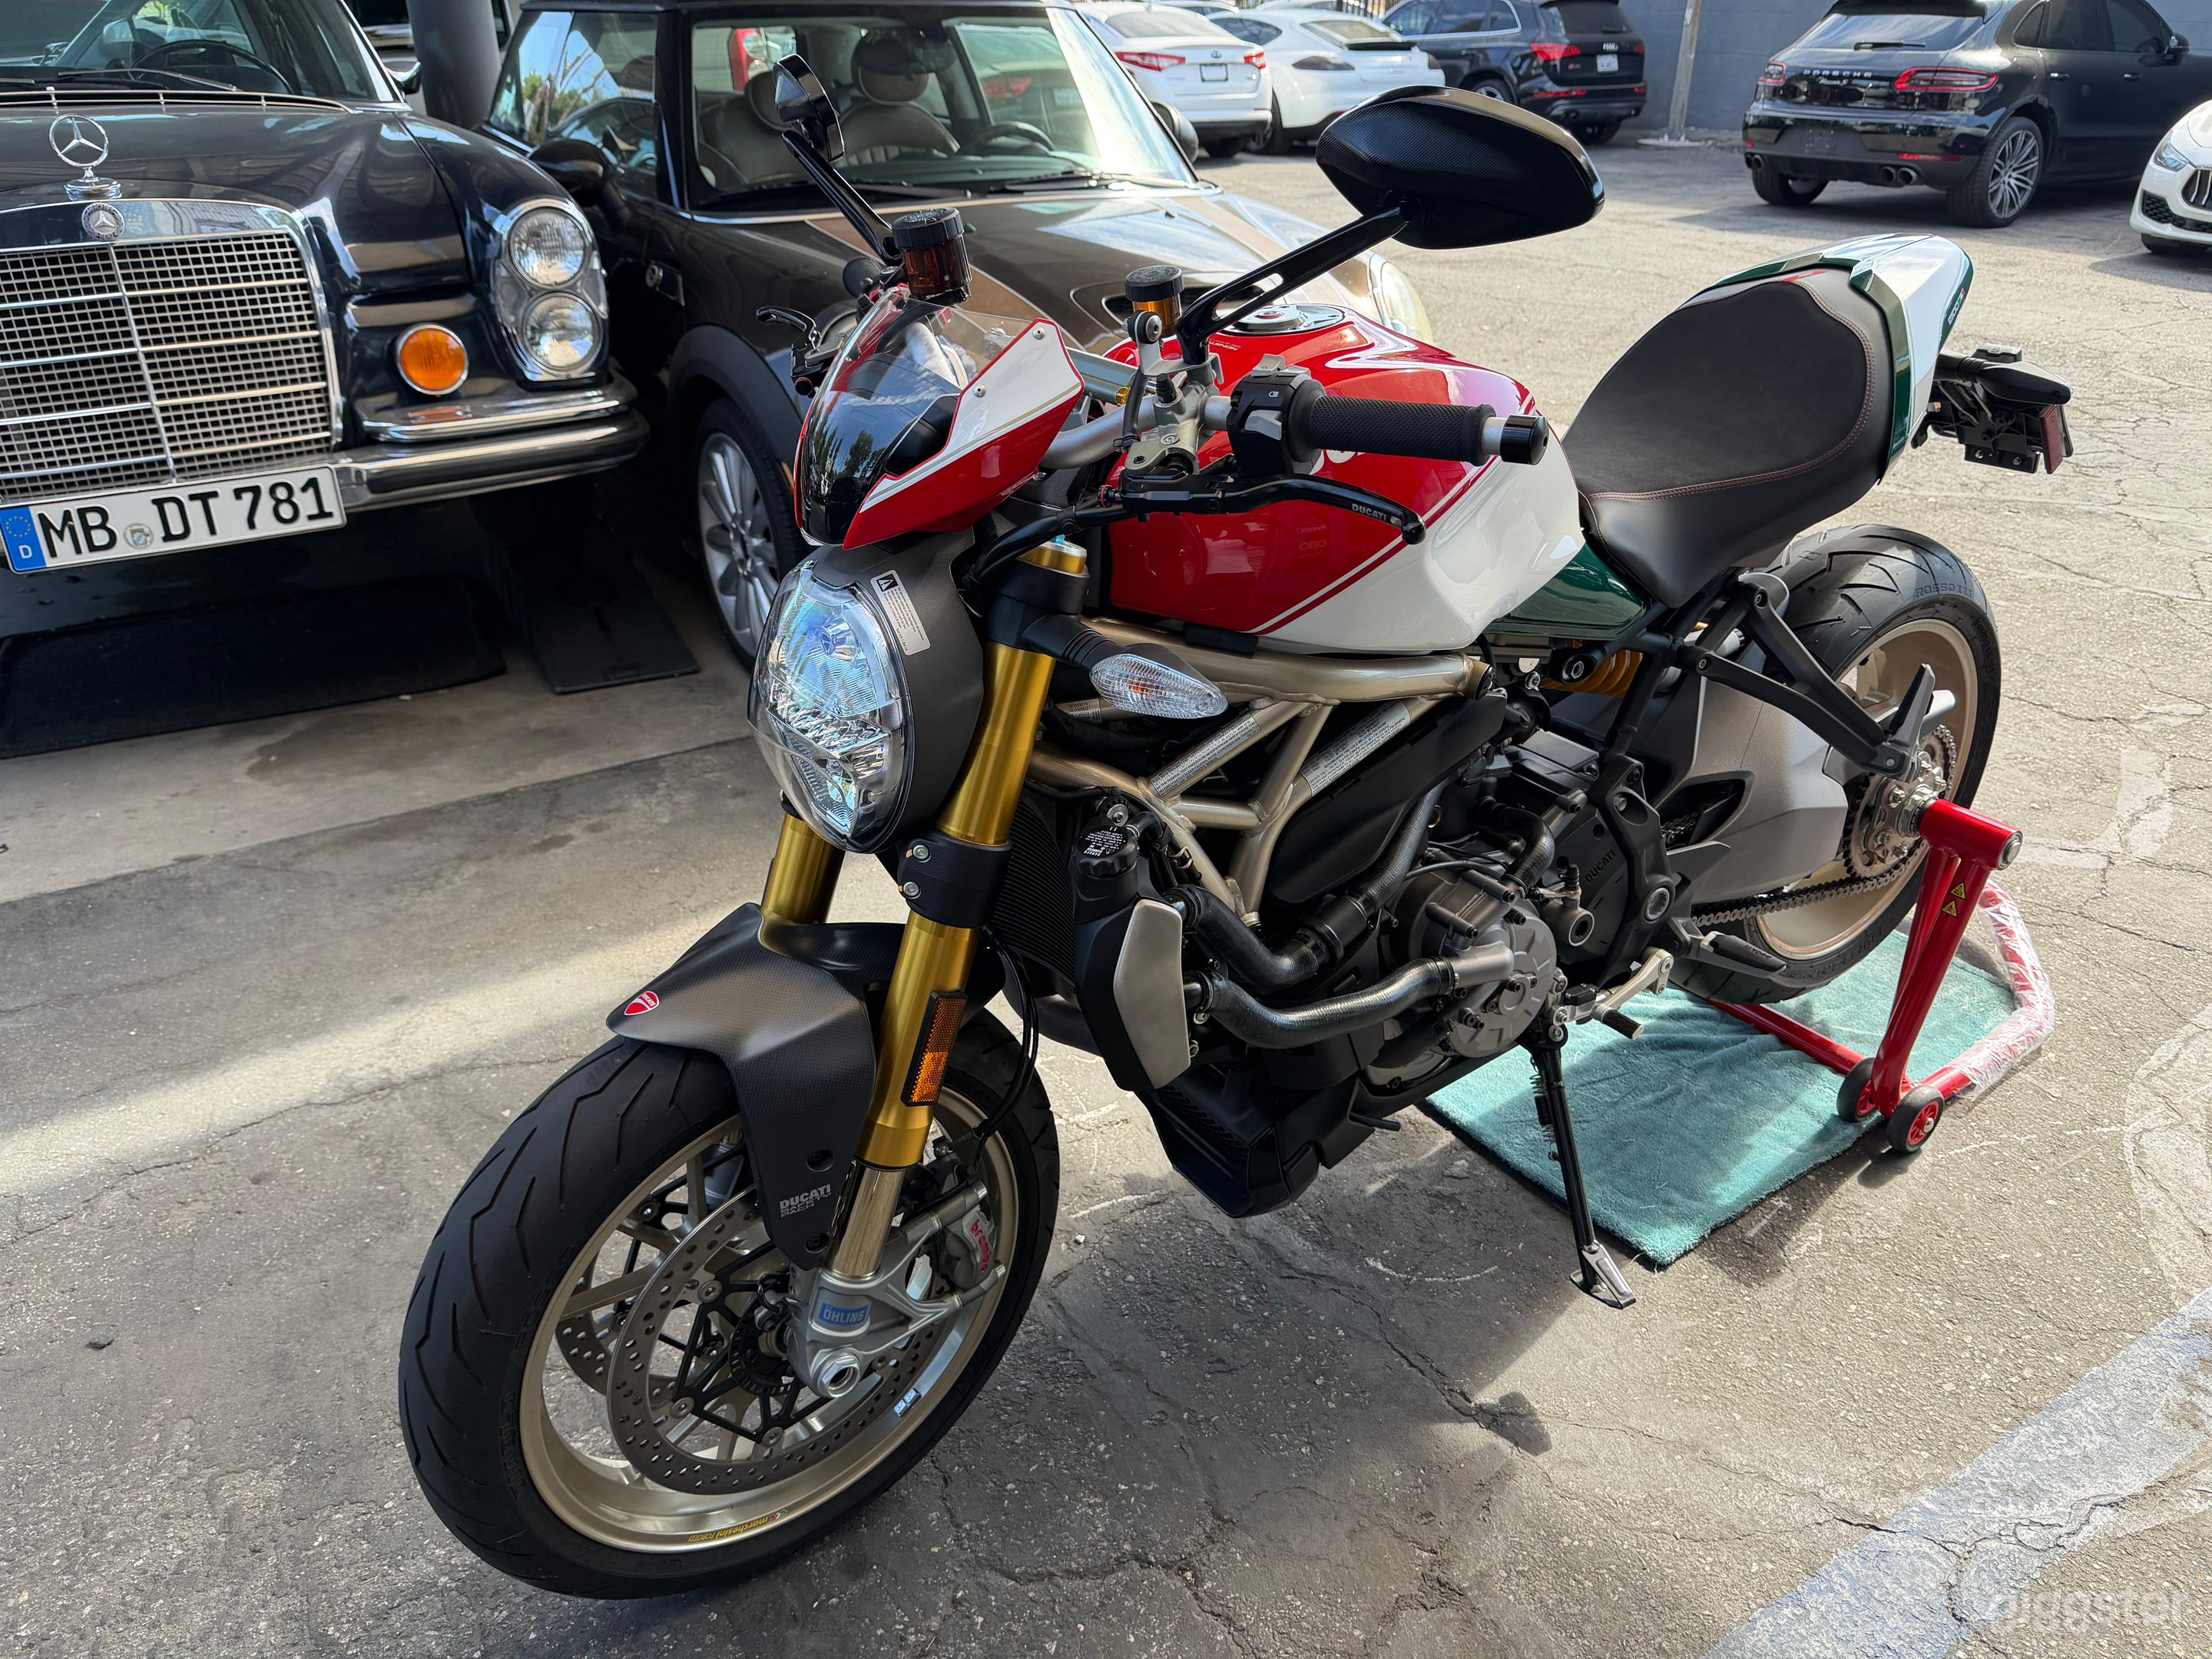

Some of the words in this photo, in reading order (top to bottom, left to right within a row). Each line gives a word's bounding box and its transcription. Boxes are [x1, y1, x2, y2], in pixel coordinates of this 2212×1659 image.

[1803, 68, 1873, 78] PORSCHE
[37, 506, 118, 558] MB
[152, 490, 221, 542] DT
[233, 476, 334, 530] 781
[1352, 503, 1387, 522] DUCATI
[21, 545, 33, 559] D
[1915, 582, 1955, 598] ROSSO
[1957, 584, 1972, 598] III
[1584, 849, 1616, 884] DUCATI
[641, 992, 657, 1007] DUCATI
[780, 1184, 831, 1210] DUCATI
[970, 1218, 992, 1273] brembo
[823, 1306, 865, 1323] ÖHLINS
[715, 1516, 768, 1539] marchesini
[688, 1532, 716, 1542] FORGED
